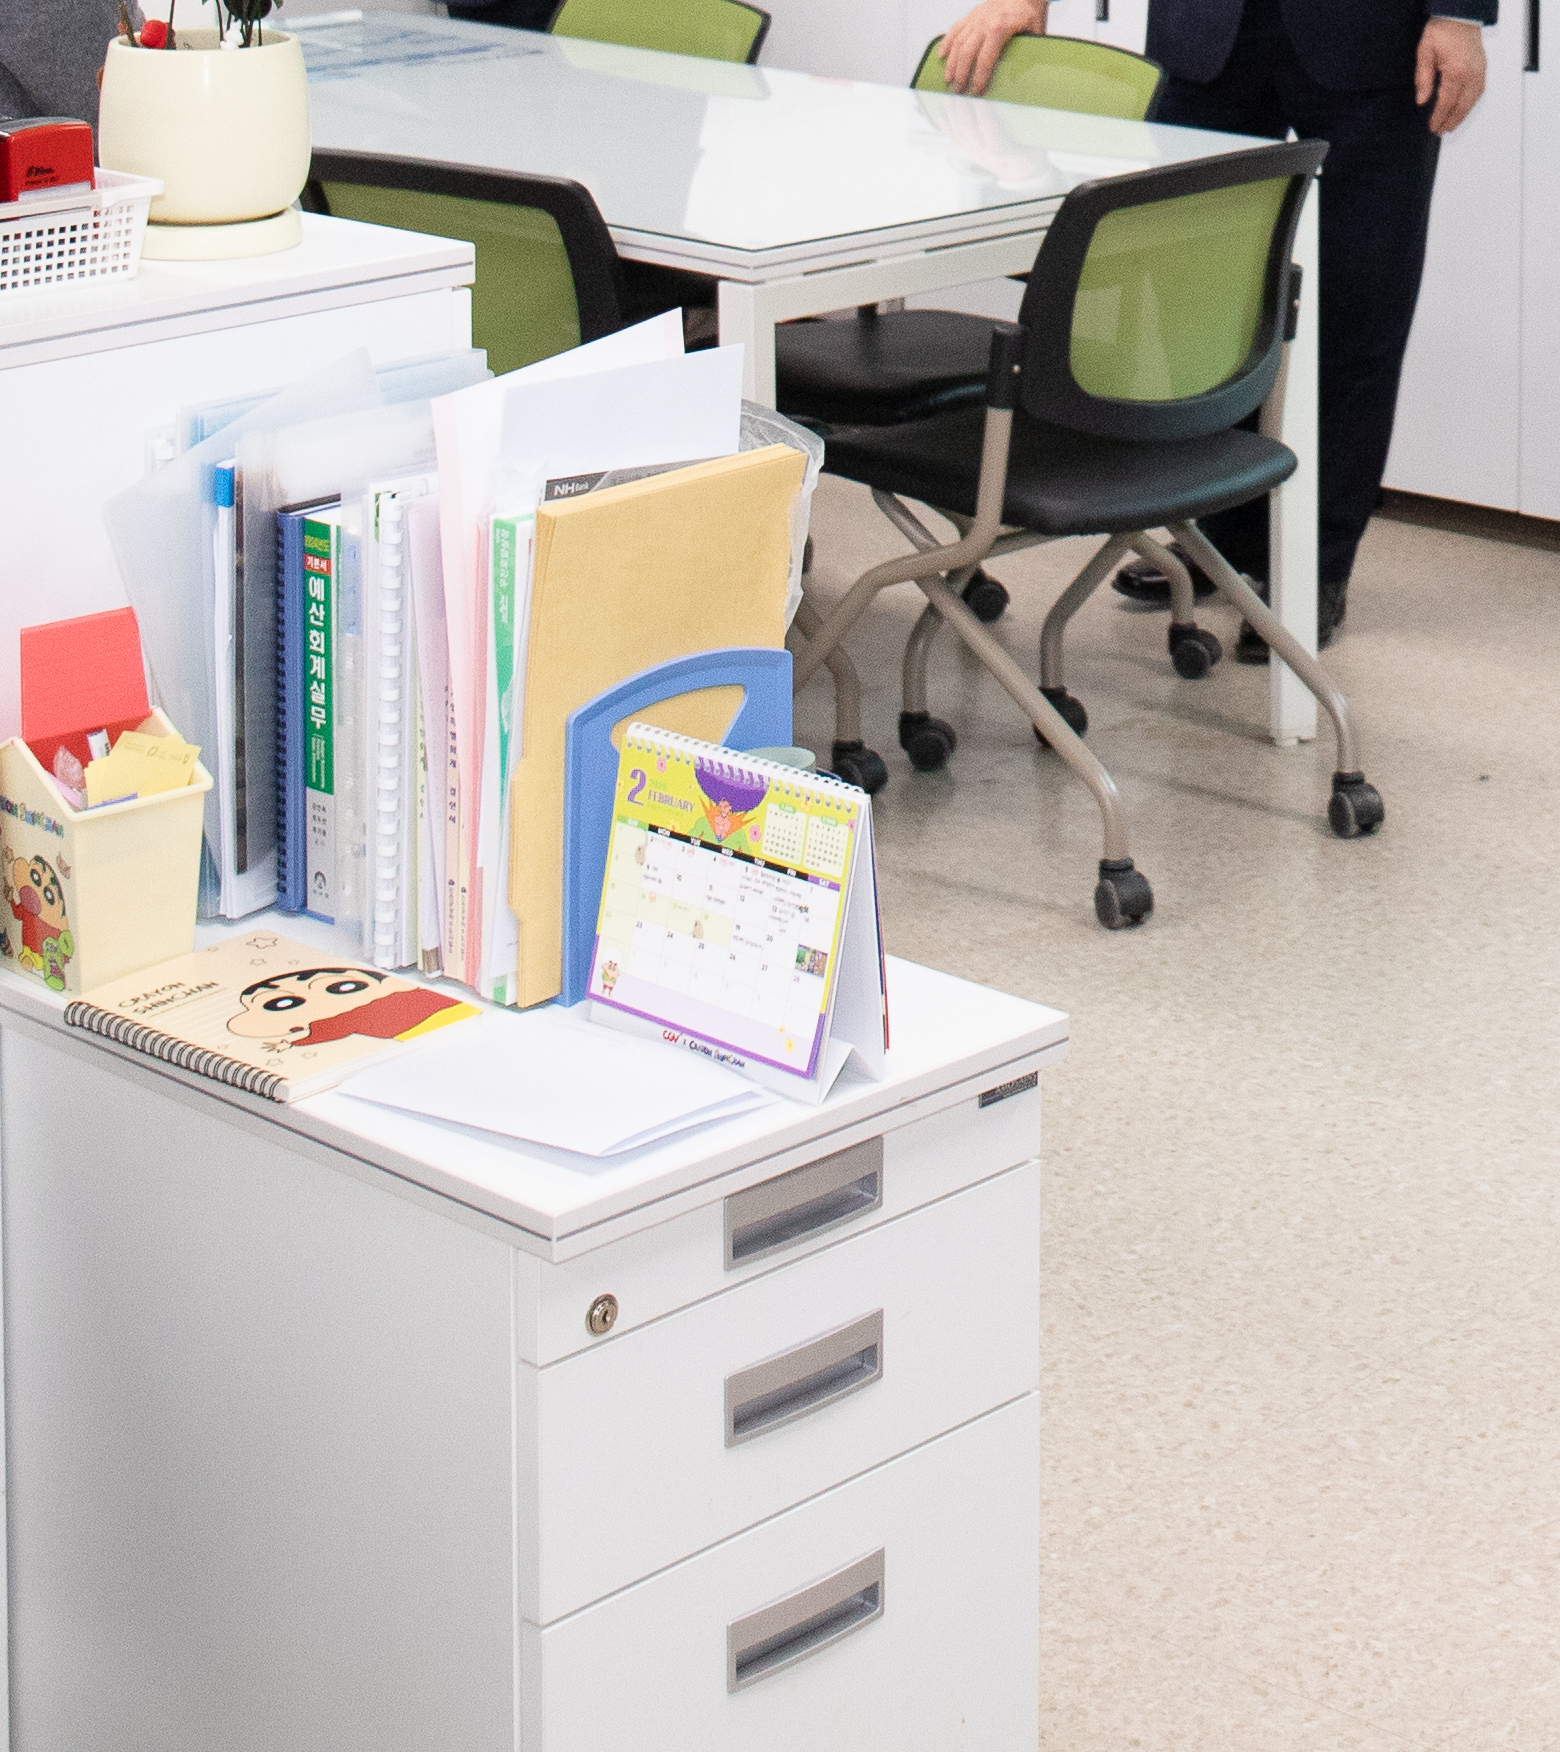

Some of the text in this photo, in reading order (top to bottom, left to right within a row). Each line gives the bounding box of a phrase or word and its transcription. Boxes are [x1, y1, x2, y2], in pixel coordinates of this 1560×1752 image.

[554, 482, 575, 496] NH
[308, 576, 326, 730] 예산회계실무
[627, 768, 647, 806] 2
[647, 789, 695, 813] FEBRUARY
[657, 827, 671, 837] MON
[818, 878, 831, 888] SAT
[662, 1029, 680, 1044] CGV
